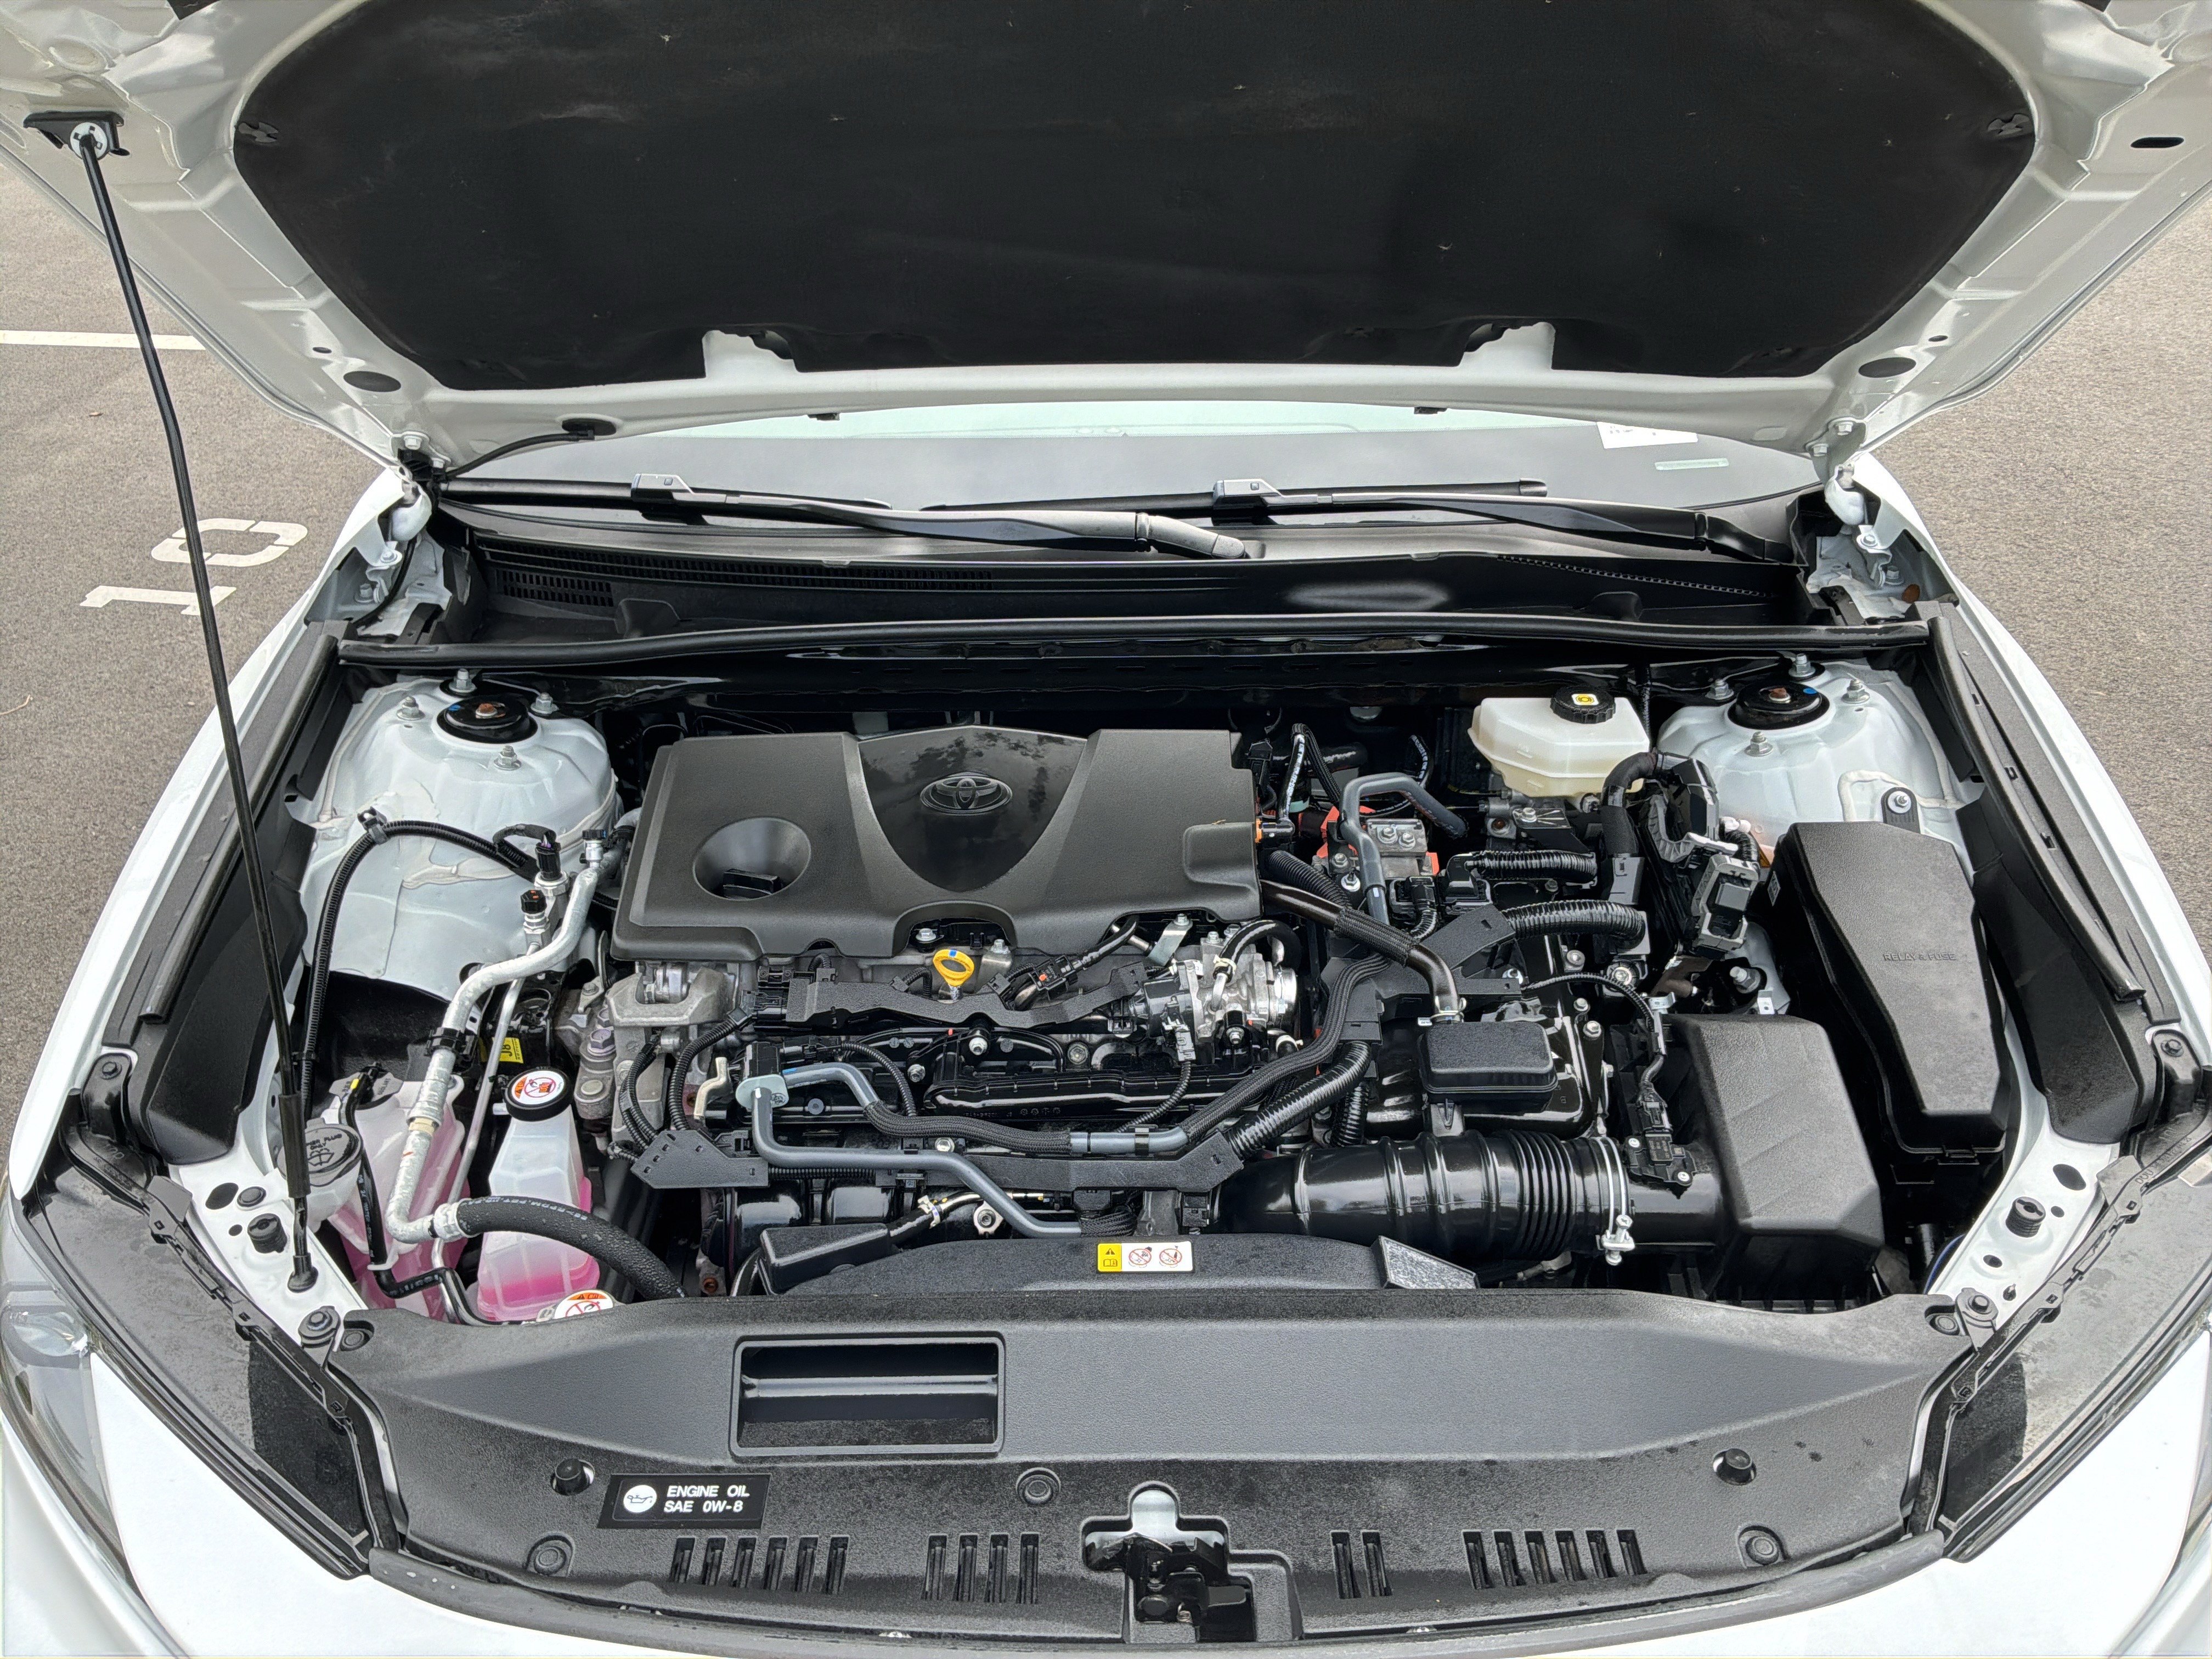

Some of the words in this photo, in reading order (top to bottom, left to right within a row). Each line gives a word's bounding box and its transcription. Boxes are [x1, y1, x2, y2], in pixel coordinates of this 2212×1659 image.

[80, 518, 308, 616] 10
[1883, 952, 1916, 961] RELAY
[1928, 952, 1957, 961] FUSE
[666, 1485, 719, 1498] ENGINE
[727, 1485, 750, 1497] OIL
[663, 1500, 693, 1513] SAE
[702, 1500, 743, 1513] 0W-8
